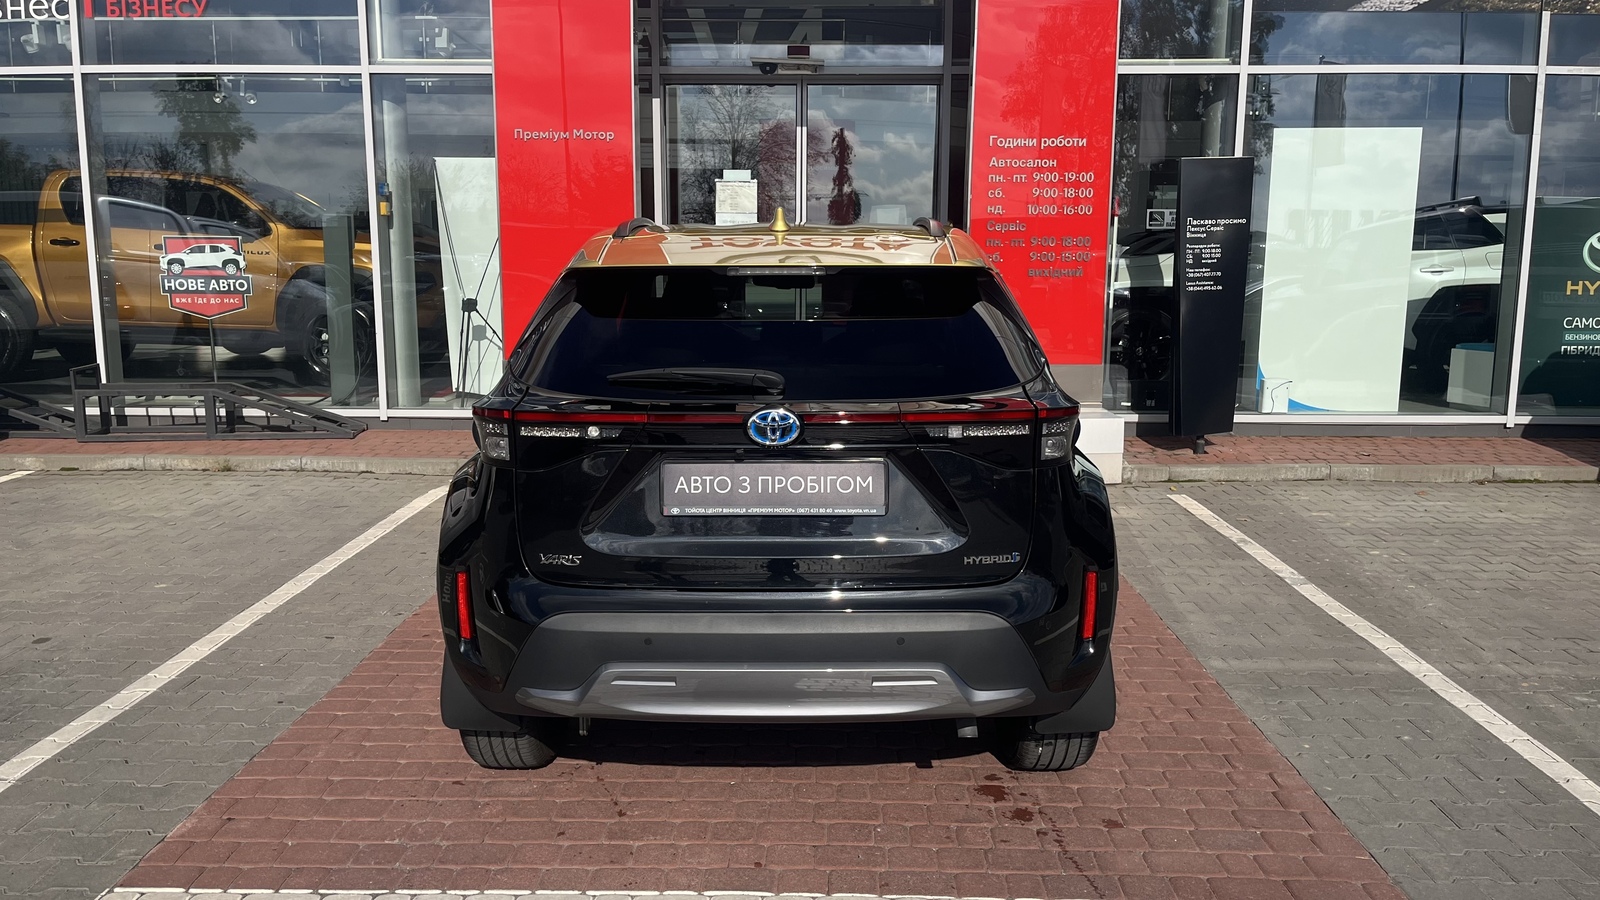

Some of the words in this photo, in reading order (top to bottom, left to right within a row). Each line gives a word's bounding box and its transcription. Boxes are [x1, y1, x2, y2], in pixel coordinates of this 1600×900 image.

[514, 128, 570, 142] Преміум
[573, 128, 615, 142] Мотор
[989, 135, 1037, 149] Години
[1041, 135, 1087, 150] роботи
[989, 157, 1057, 168] Автосалон
[1032, 171, 1095, 183] 9:00-19:00
[988, 187, 1006, 198] сб.
[1032, 187, 1094, 198] 9:00-18:00
[987, 205, 1006, 215] нд.
[1027, 204, 1093, 215] 10:00-16:00
[987, 220, 1027, 233] Сервіс
[1206, 224, 1224, 232] Сервіс
[1030, 236, 1092, 247] 9:00-18:00
[1029, 252, 1092, 262] 9:00-15:00
[1028, 266, 1083, 278] вихідний
[164, 279, 206, 291] НОВЕ
[209, 279, 248, 291] АВТО
[194, 296, 207, 304] ЇДЕ
[210, 297, 221, 305] ДО
[674, 476, 732, 494] АВТО
[738, 476, 750, 494] З
[758, 476, 873, 494] ПРОБІГОМ
[539, 553, 582, 566] YARIS
[963, 554, 1012, 565] HYBRID
